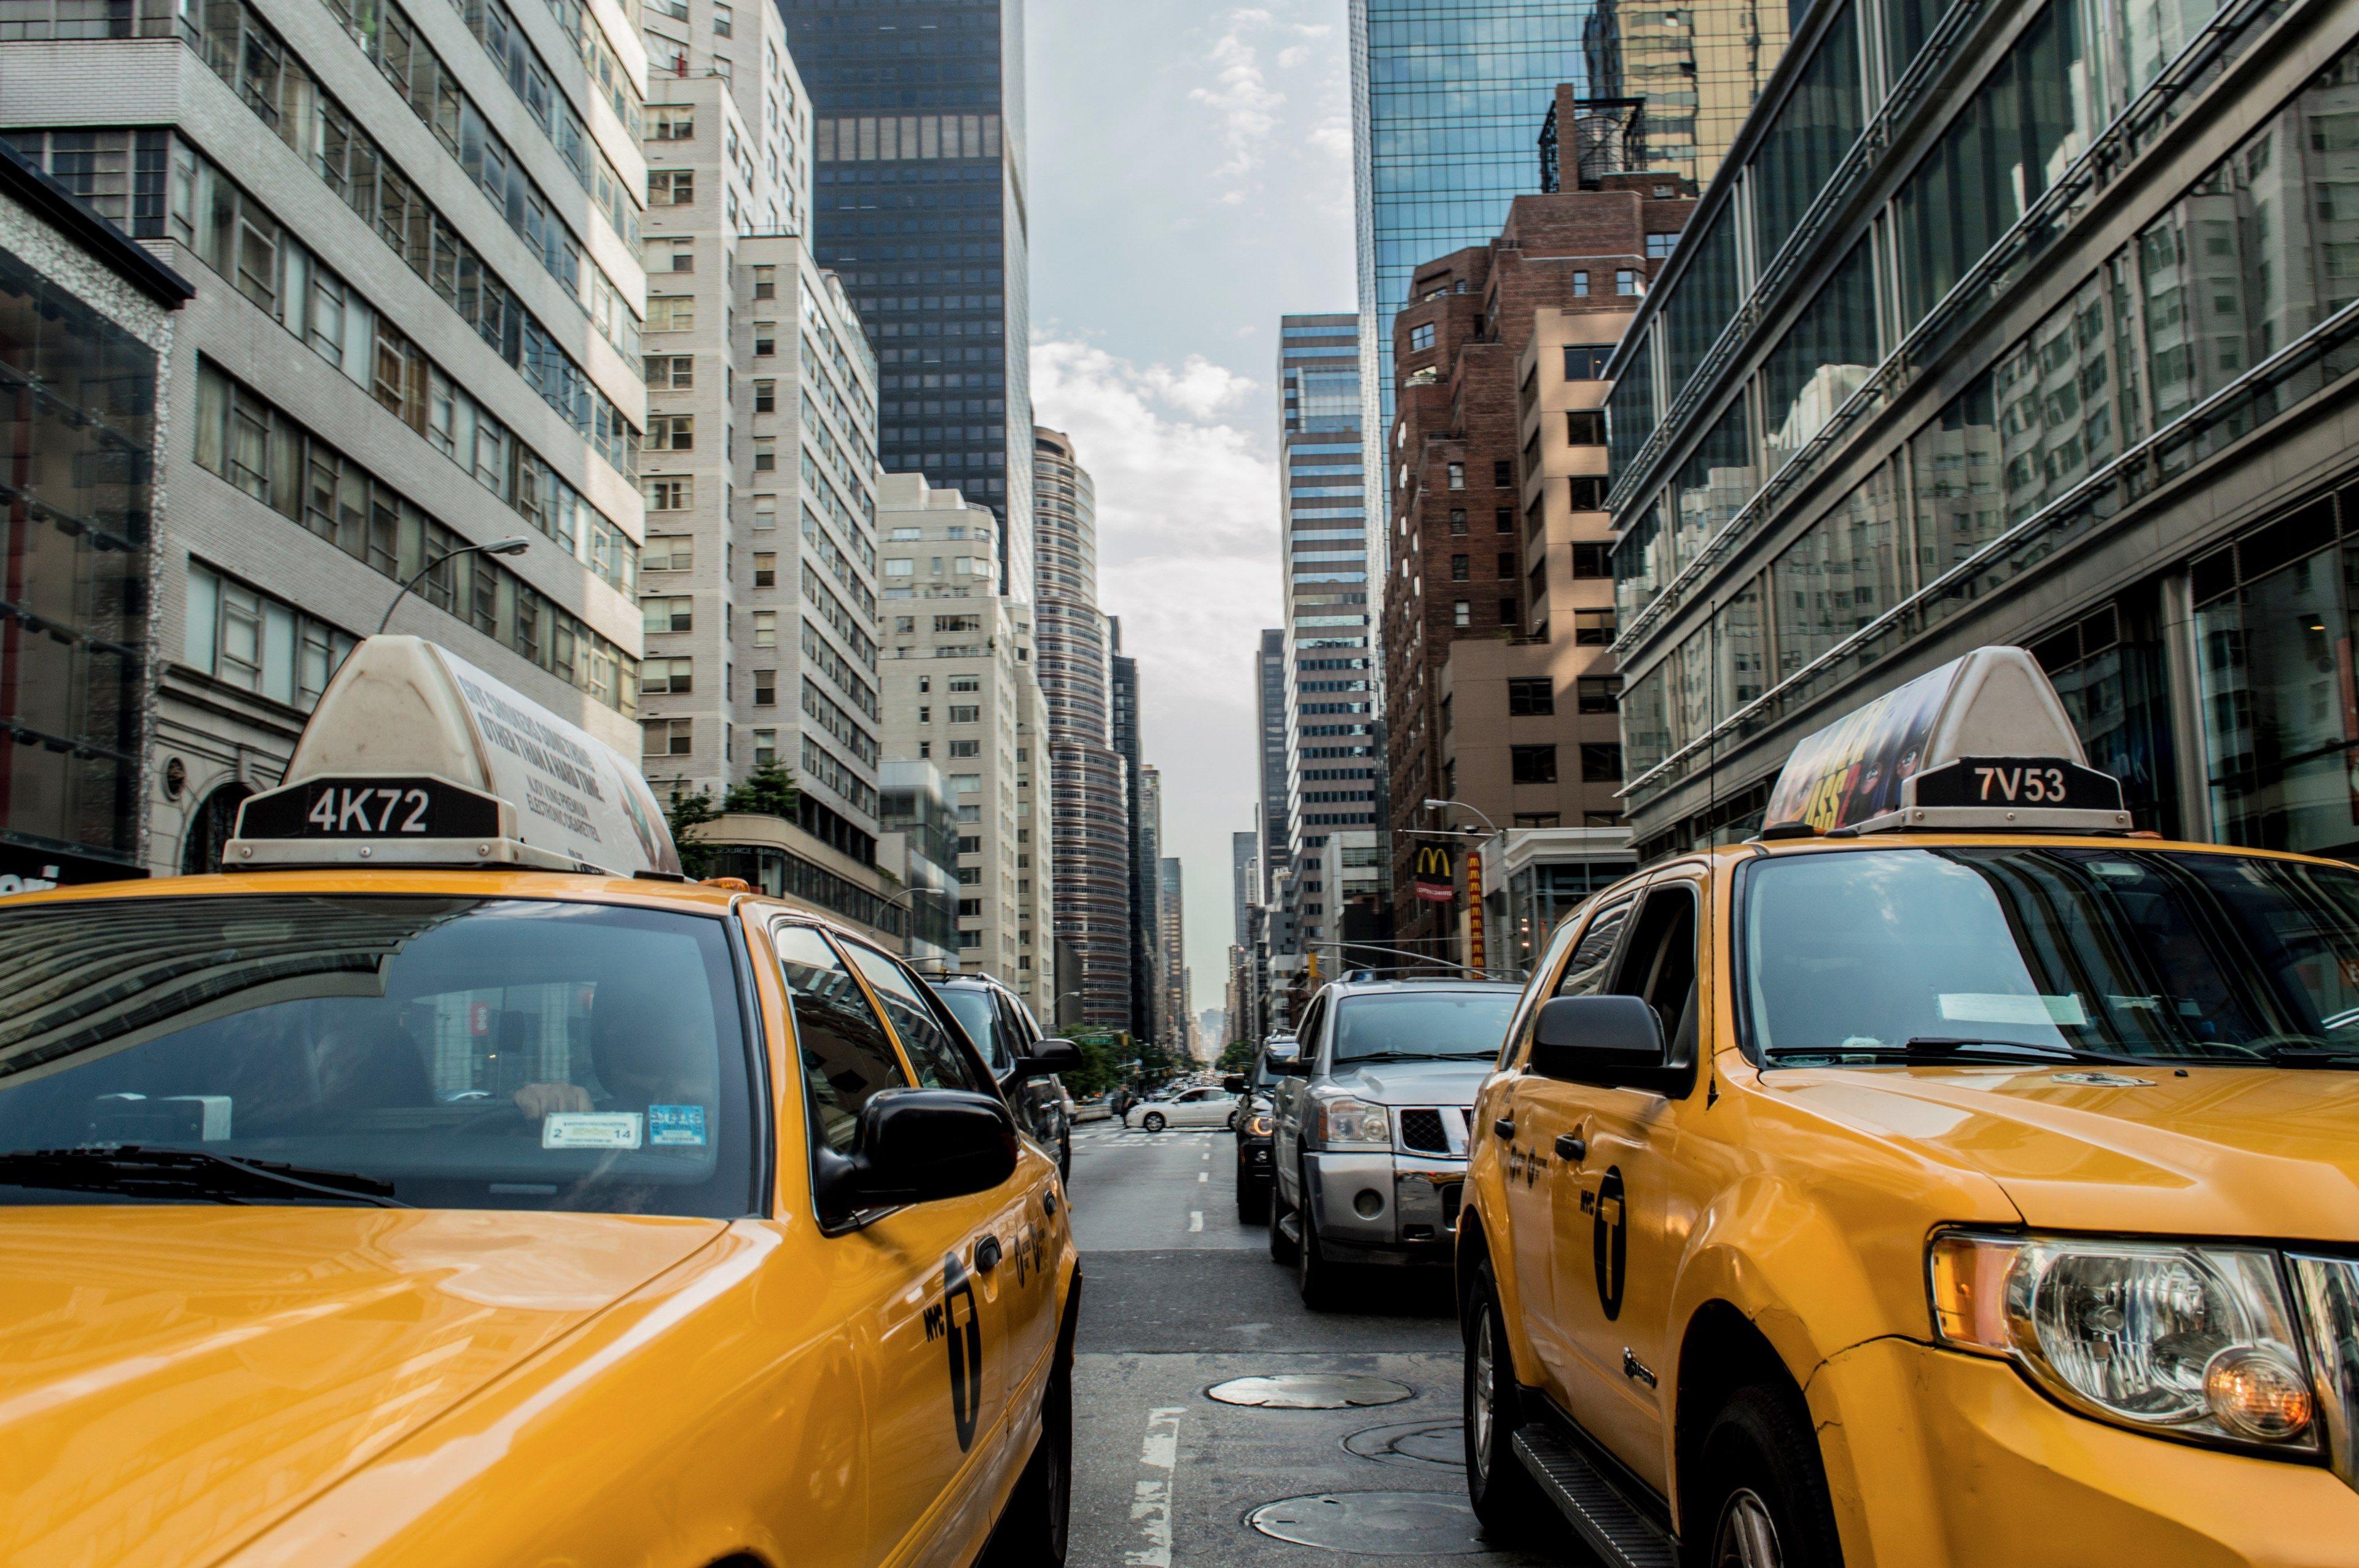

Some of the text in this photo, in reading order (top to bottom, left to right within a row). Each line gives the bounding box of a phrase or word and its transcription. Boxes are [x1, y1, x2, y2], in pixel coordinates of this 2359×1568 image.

[477, 711, 522, 757] OTHER
[513, 731, 547, 772] THAN
[1974, 767, 2066, 802] 7V53
[309, 788, 429, 832] 4K72
[553, 1128, 563, 1138] 2
[615, 1129, 631, 1139] 14
[1580, 1188, 1595, 1217] NYC
[923, 1302, 945, 1343] NYC
